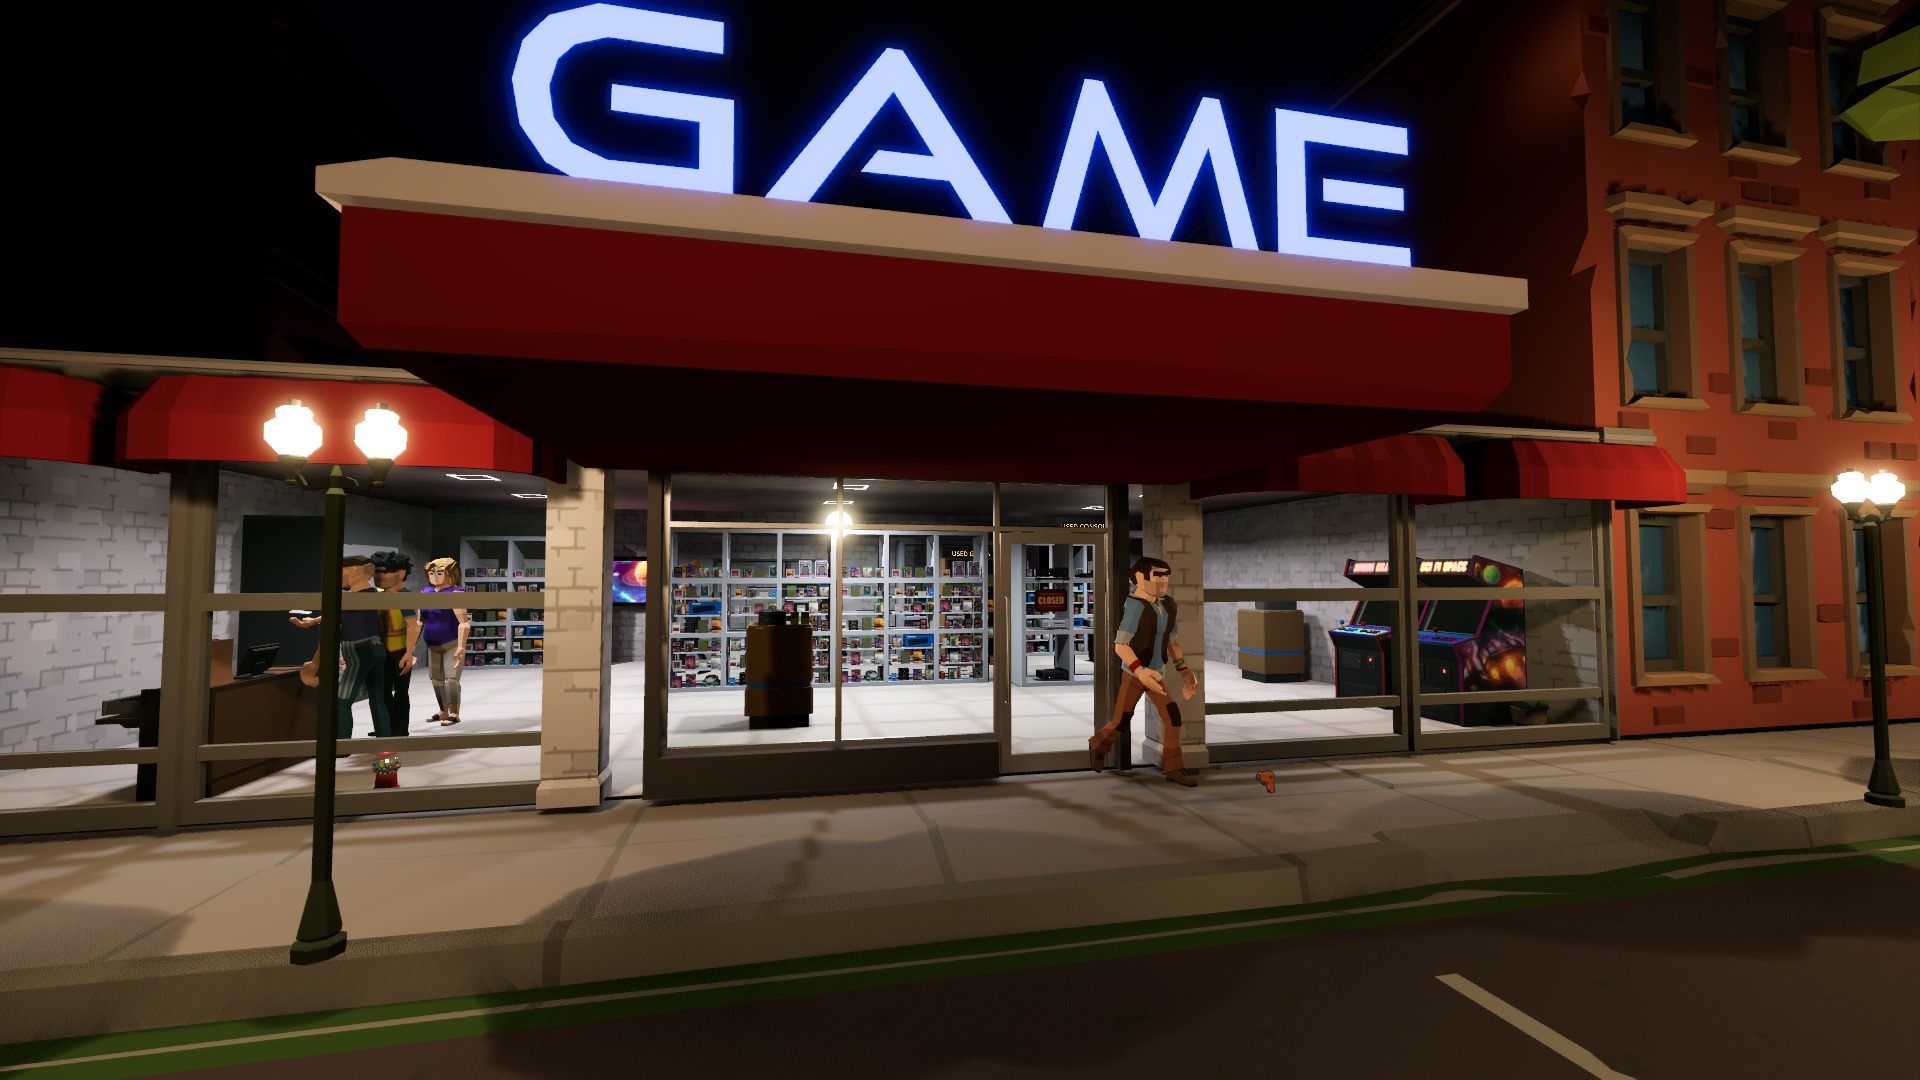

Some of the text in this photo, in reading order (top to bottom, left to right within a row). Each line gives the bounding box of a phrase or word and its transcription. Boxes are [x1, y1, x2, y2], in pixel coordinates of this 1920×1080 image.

[511, 2, 1412, 267] GAME
[1442, 560, 1469, 573] SPACE
[1038, 596, 1065, 605] CLOSED
